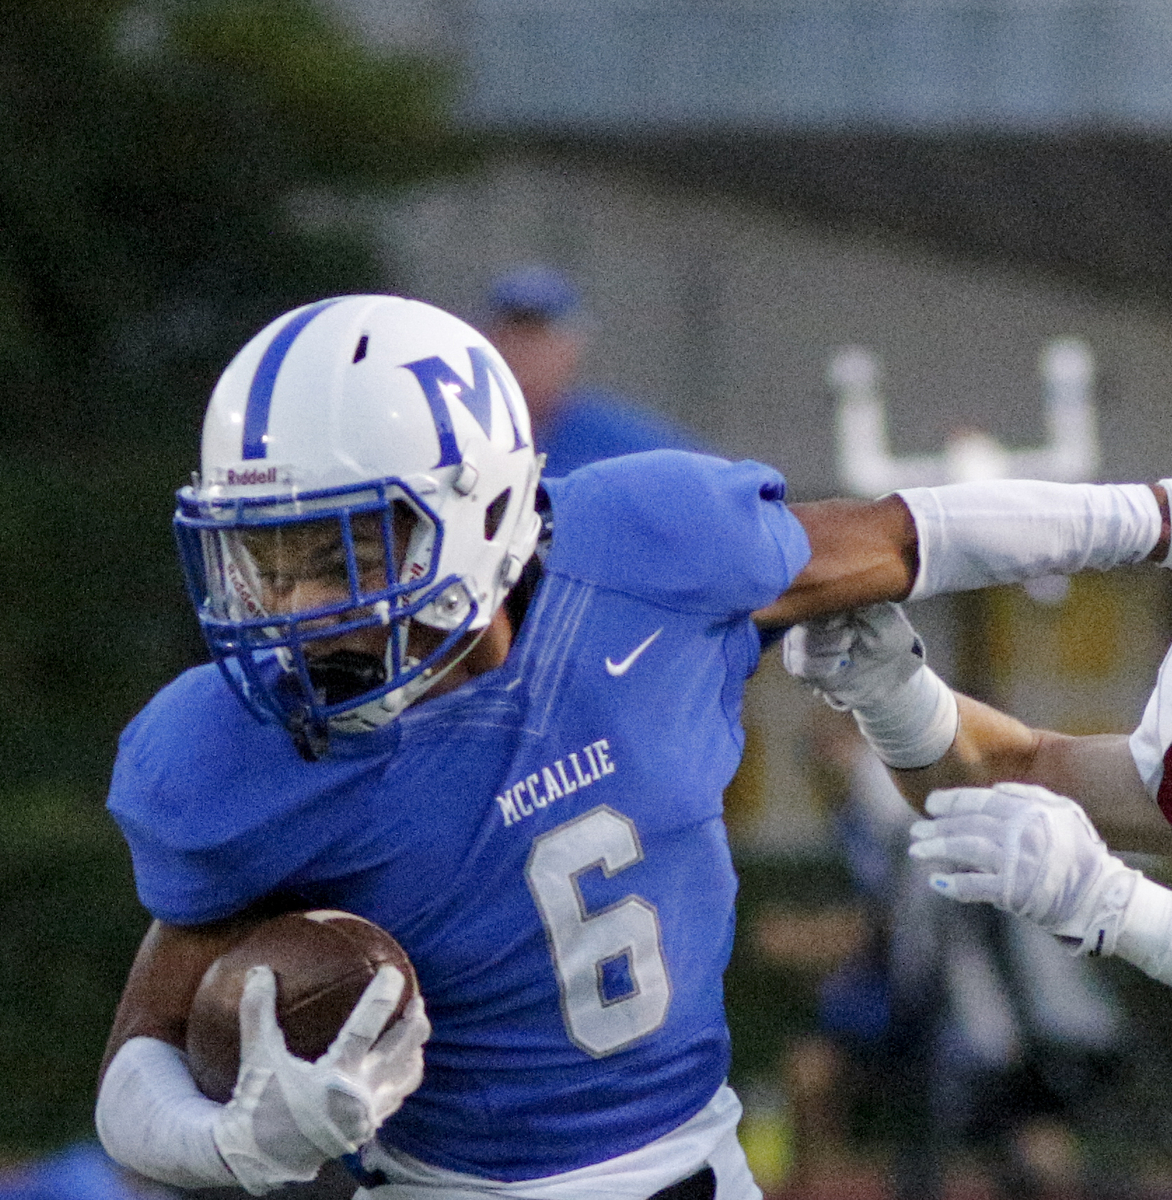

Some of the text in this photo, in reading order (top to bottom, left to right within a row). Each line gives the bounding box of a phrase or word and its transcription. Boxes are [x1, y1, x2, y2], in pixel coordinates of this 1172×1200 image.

[398, 346, 528, 469] M
[227, 466, 277, 486] Riddell
[496, 739, 615, 827] MCCALLIE
[524, 803, 672, 1059] 6
